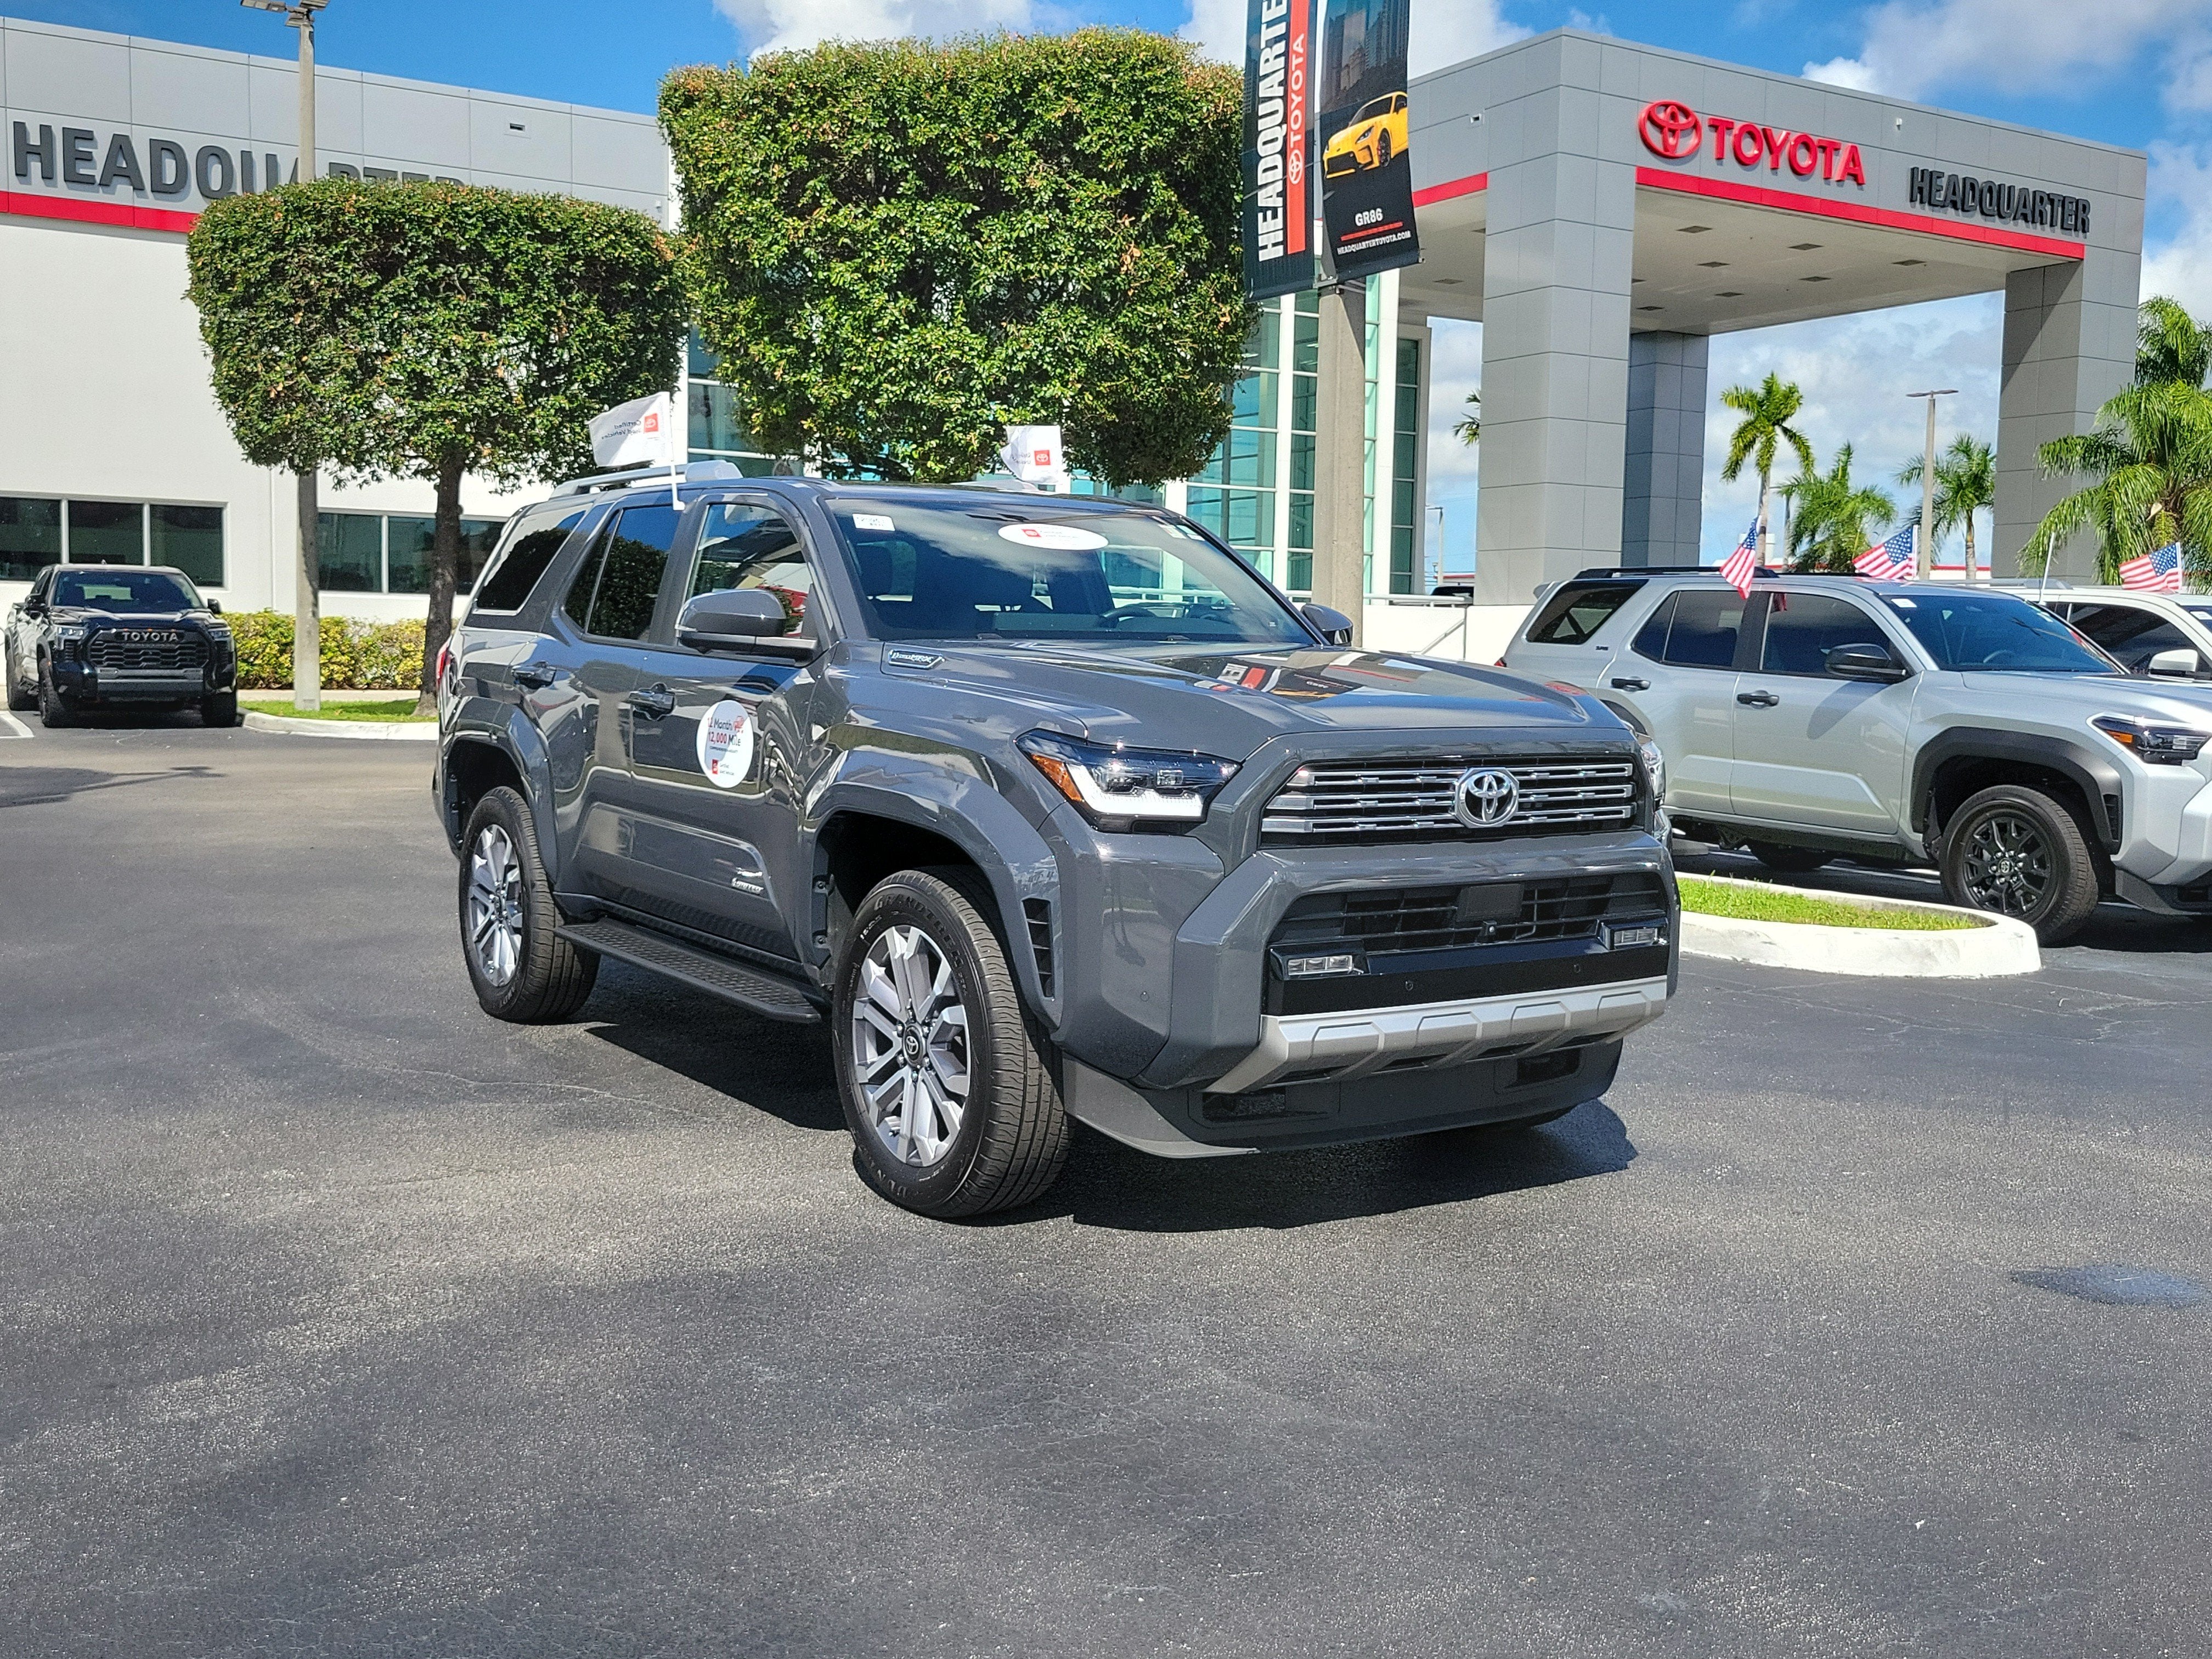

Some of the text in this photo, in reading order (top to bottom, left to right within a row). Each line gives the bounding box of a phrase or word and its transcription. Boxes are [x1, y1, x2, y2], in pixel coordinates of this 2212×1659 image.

[1289, 33, 1305, 143] TOYOTA
[13, 121, 465, 199] HEADQU
[1707, 117, 1865, 185] TOYOTA
[1355, 208, 1383, 226] GR86
[1909, 166, 2091, 233] HEADQUARTER
[1337, 230, 1412, 255] HEADQUARTERTOYOTA.COM
[122, 632, 179, 642] TOYOTA
[708, 731, 727, 744] 12,000
